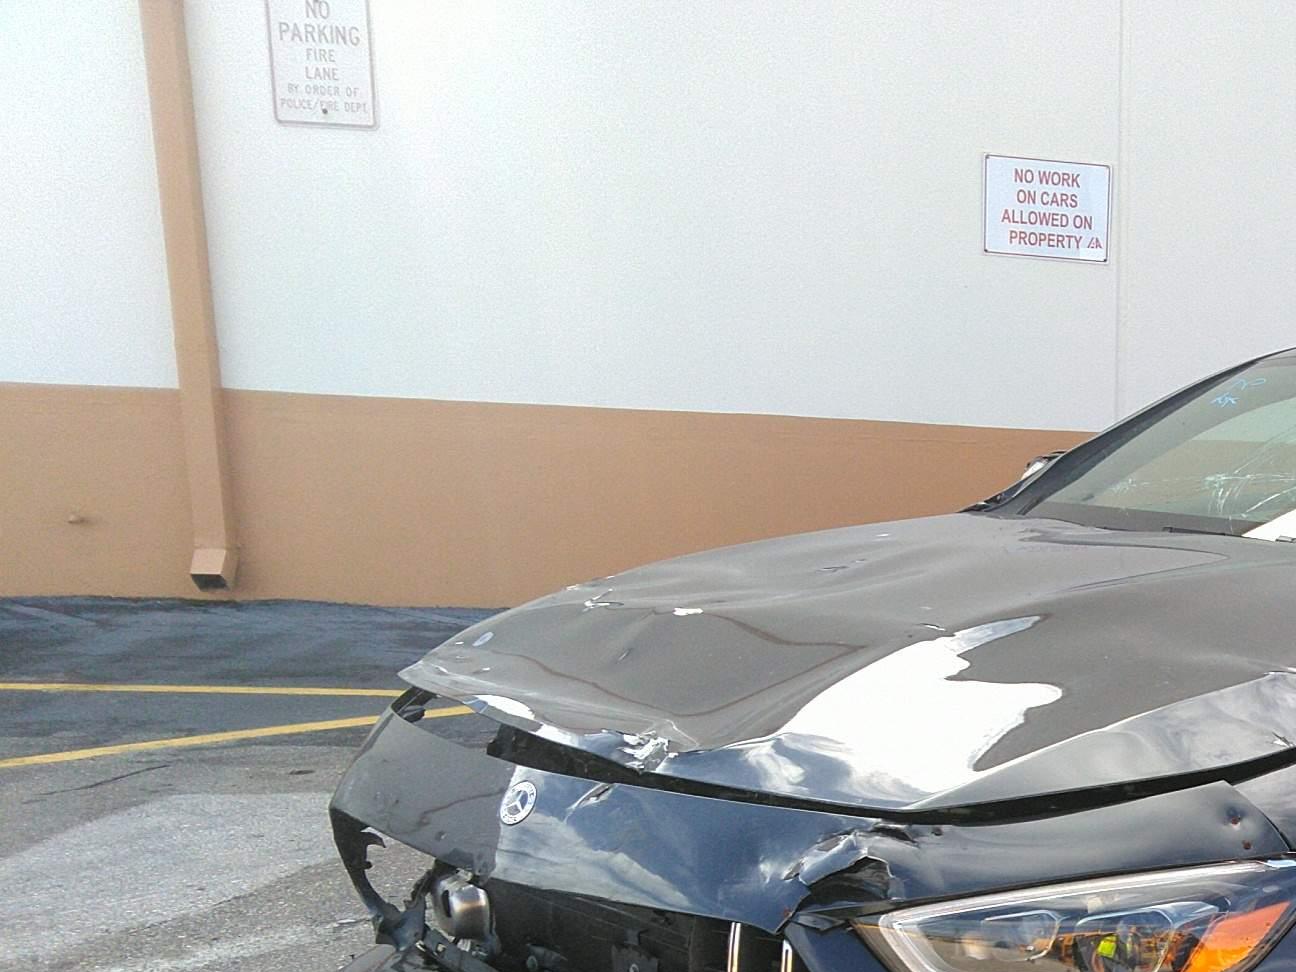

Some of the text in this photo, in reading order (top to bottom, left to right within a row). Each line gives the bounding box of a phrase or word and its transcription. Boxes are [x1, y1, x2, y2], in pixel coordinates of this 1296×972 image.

[305, 0, 331, 19] NO
[278, 21, 361, 46] PARKING
[306, 48, 336, 63] FIRE
[305, 66, 339, 81] LANE
[287, 82, 360, 98] BY ORDER OF
[1014, 168, 1081, 189] NO WORK
[1016, 189, 1079, 209] ON CARS
[1001, 208, 1093, 230] ALLOWED ON
[1009, 230, 1083, 249] PROPERTY
